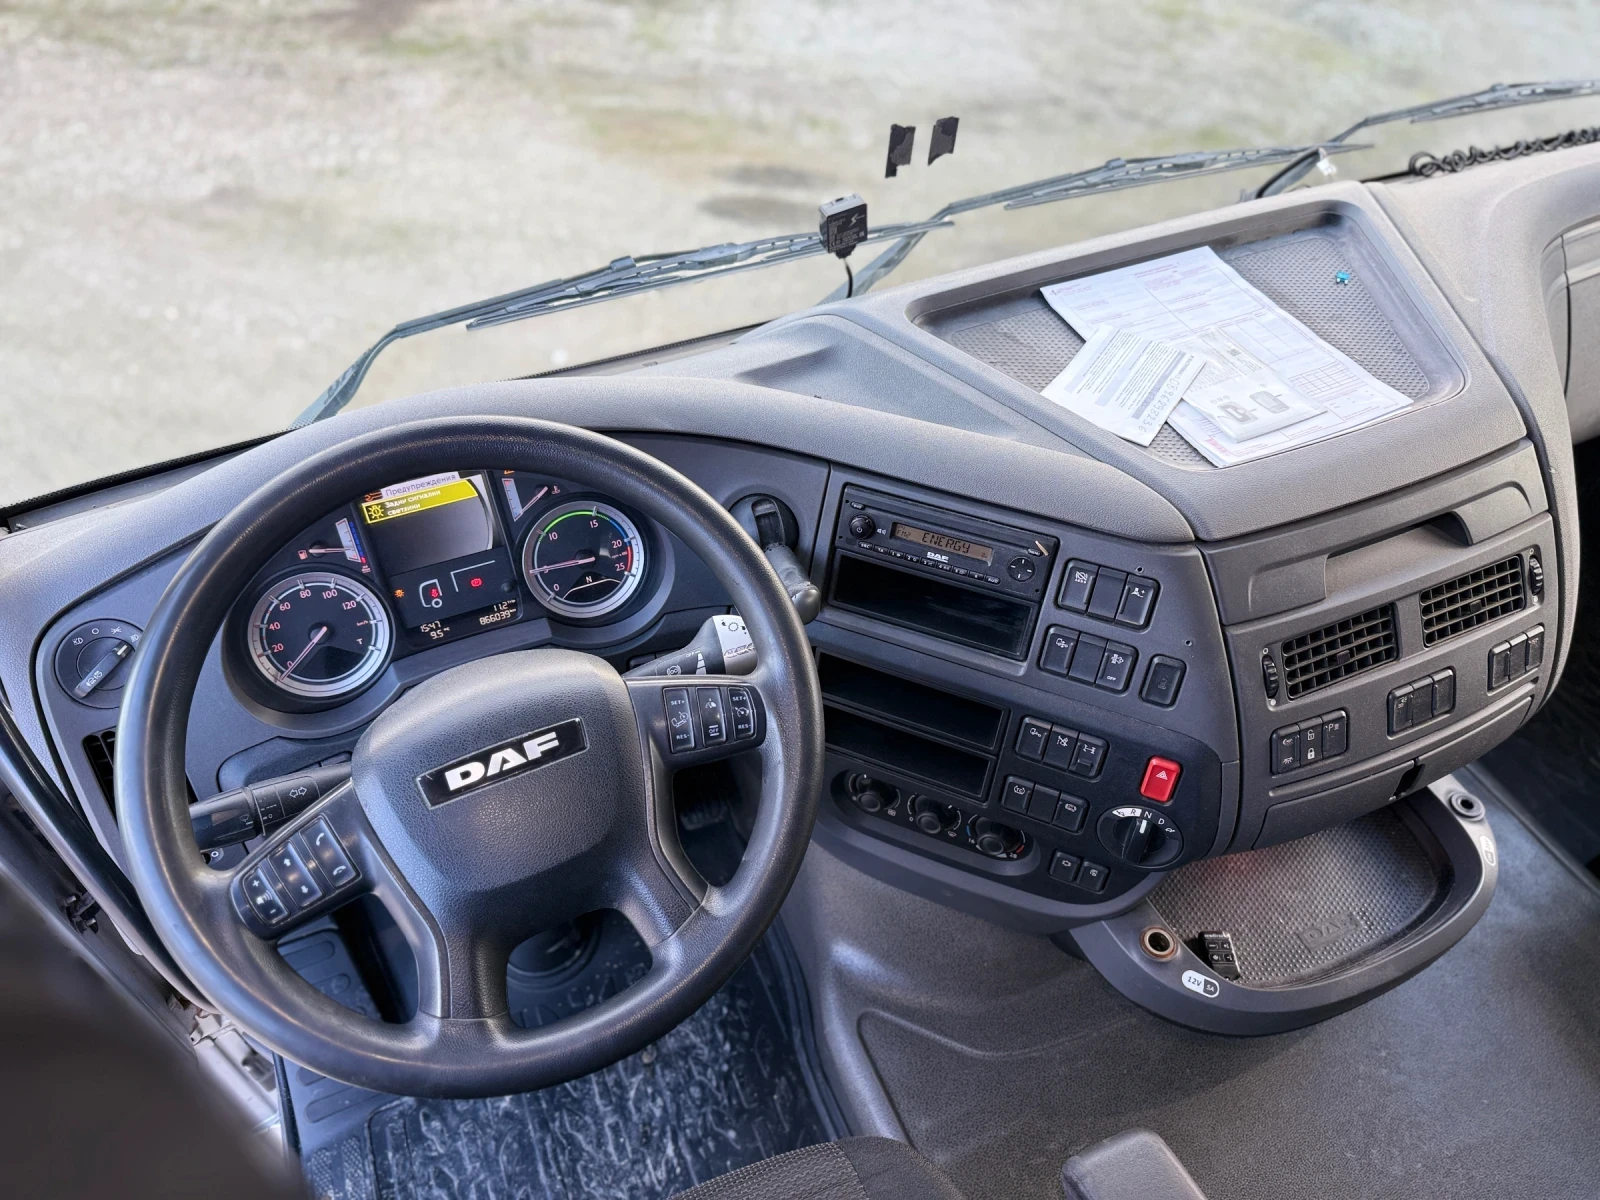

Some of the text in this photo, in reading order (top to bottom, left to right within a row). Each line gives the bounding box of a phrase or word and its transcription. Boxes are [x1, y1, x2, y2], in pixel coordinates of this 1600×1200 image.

[385, 474, 457, 497] Предупреждения
[589, 519, 599, 528] 15
[548, 531, 558, 540] 10
[611, 539, 622, 549] 20
[921, 532, 971, 554] ENERGY
[615, 562, 626, 572] 25
[585, 576, 593, 584] N
[553, 583, 560, 591] 0
[300, 589, 312, 599] 80
[322, 589, 338, 599] 100
[279, 601, 291, 612] 60
[342, 600, 357, 611] 120
[479, 610, 511, 625] 866039
[268, 621, 281, 631] 40
[271, 643, 284, 653] 20
[445, 731, 560, 791] DAF
[1130, 808, 1166, 826] R N D
[1187, 975, 1204, 987] 12V
